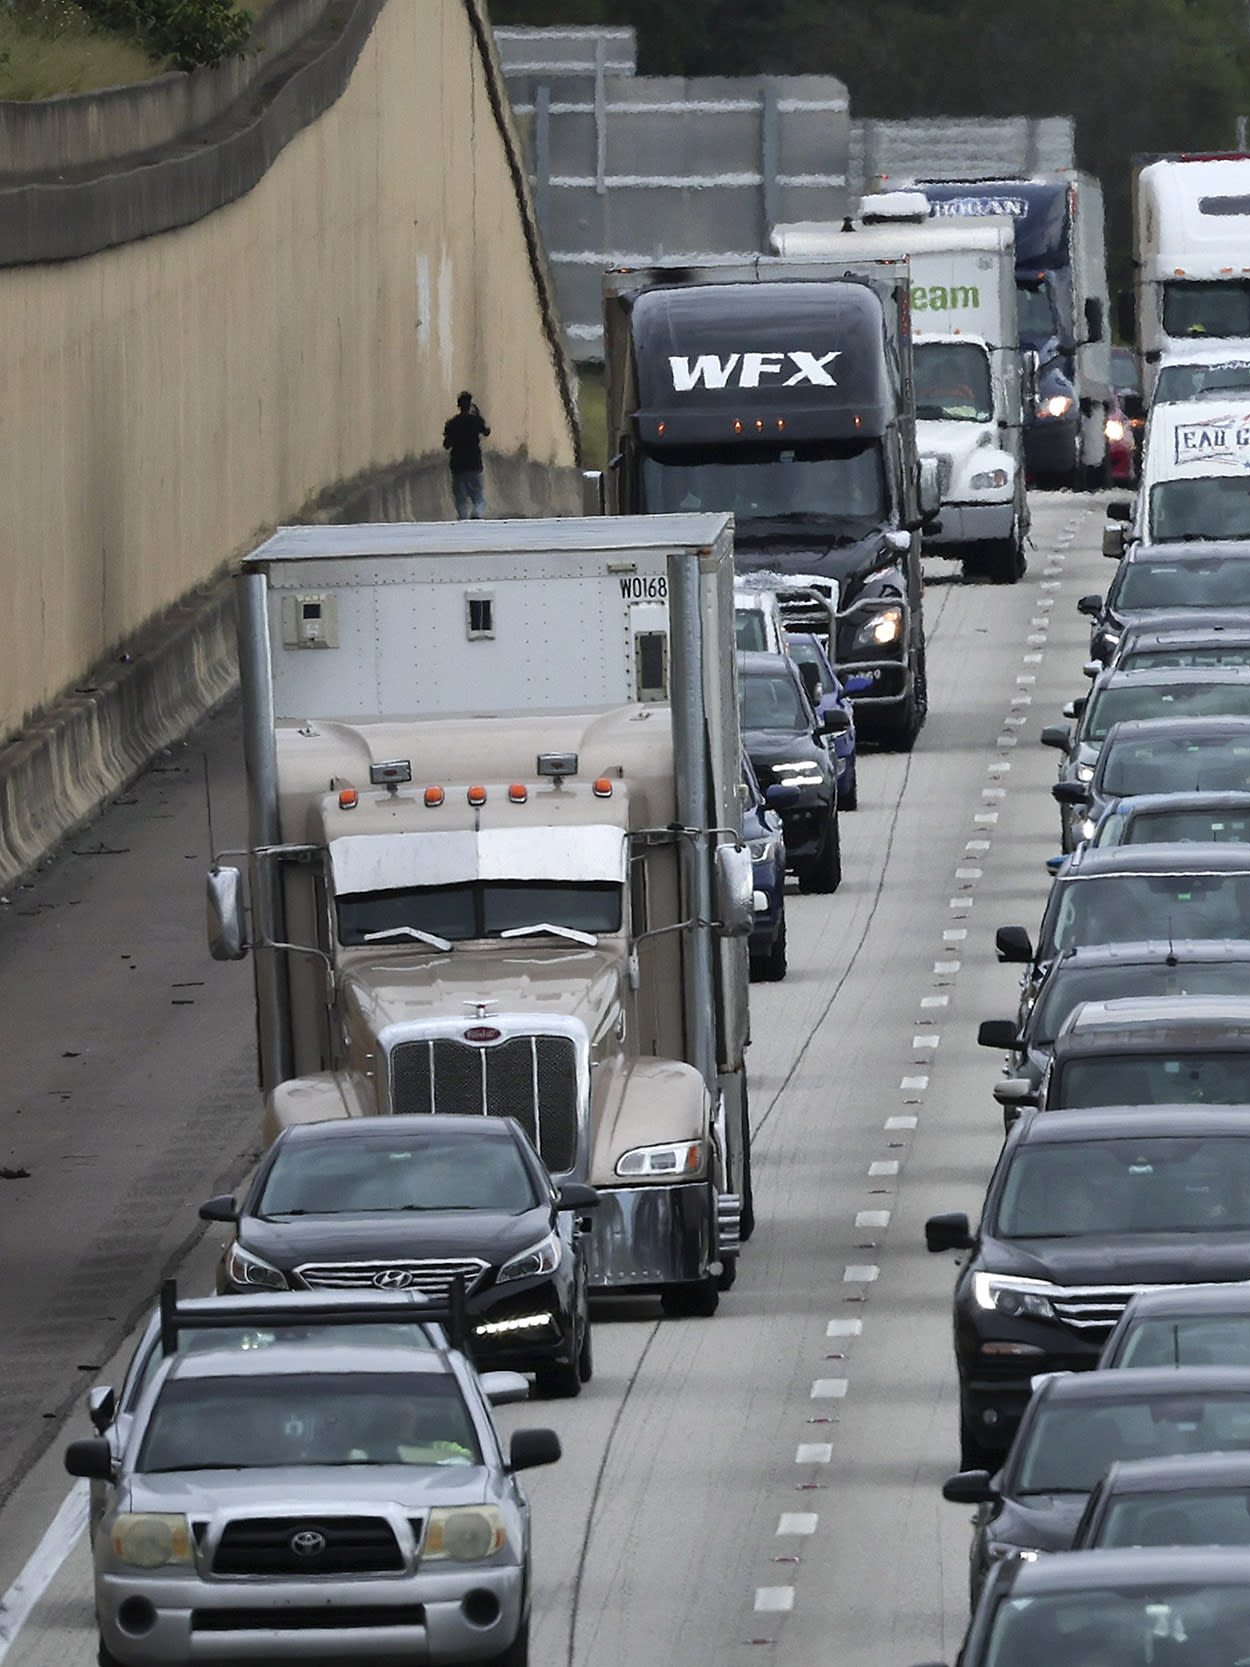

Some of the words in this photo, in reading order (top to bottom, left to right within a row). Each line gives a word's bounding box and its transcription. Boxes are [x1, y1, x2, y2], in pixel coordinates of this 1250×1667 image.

[909, 285, 979, 311] eam
[668, 351, 842, 391] WFX
[1183, 429, 1226, 448] EAU
[620, 576, 667, 599] W0168
